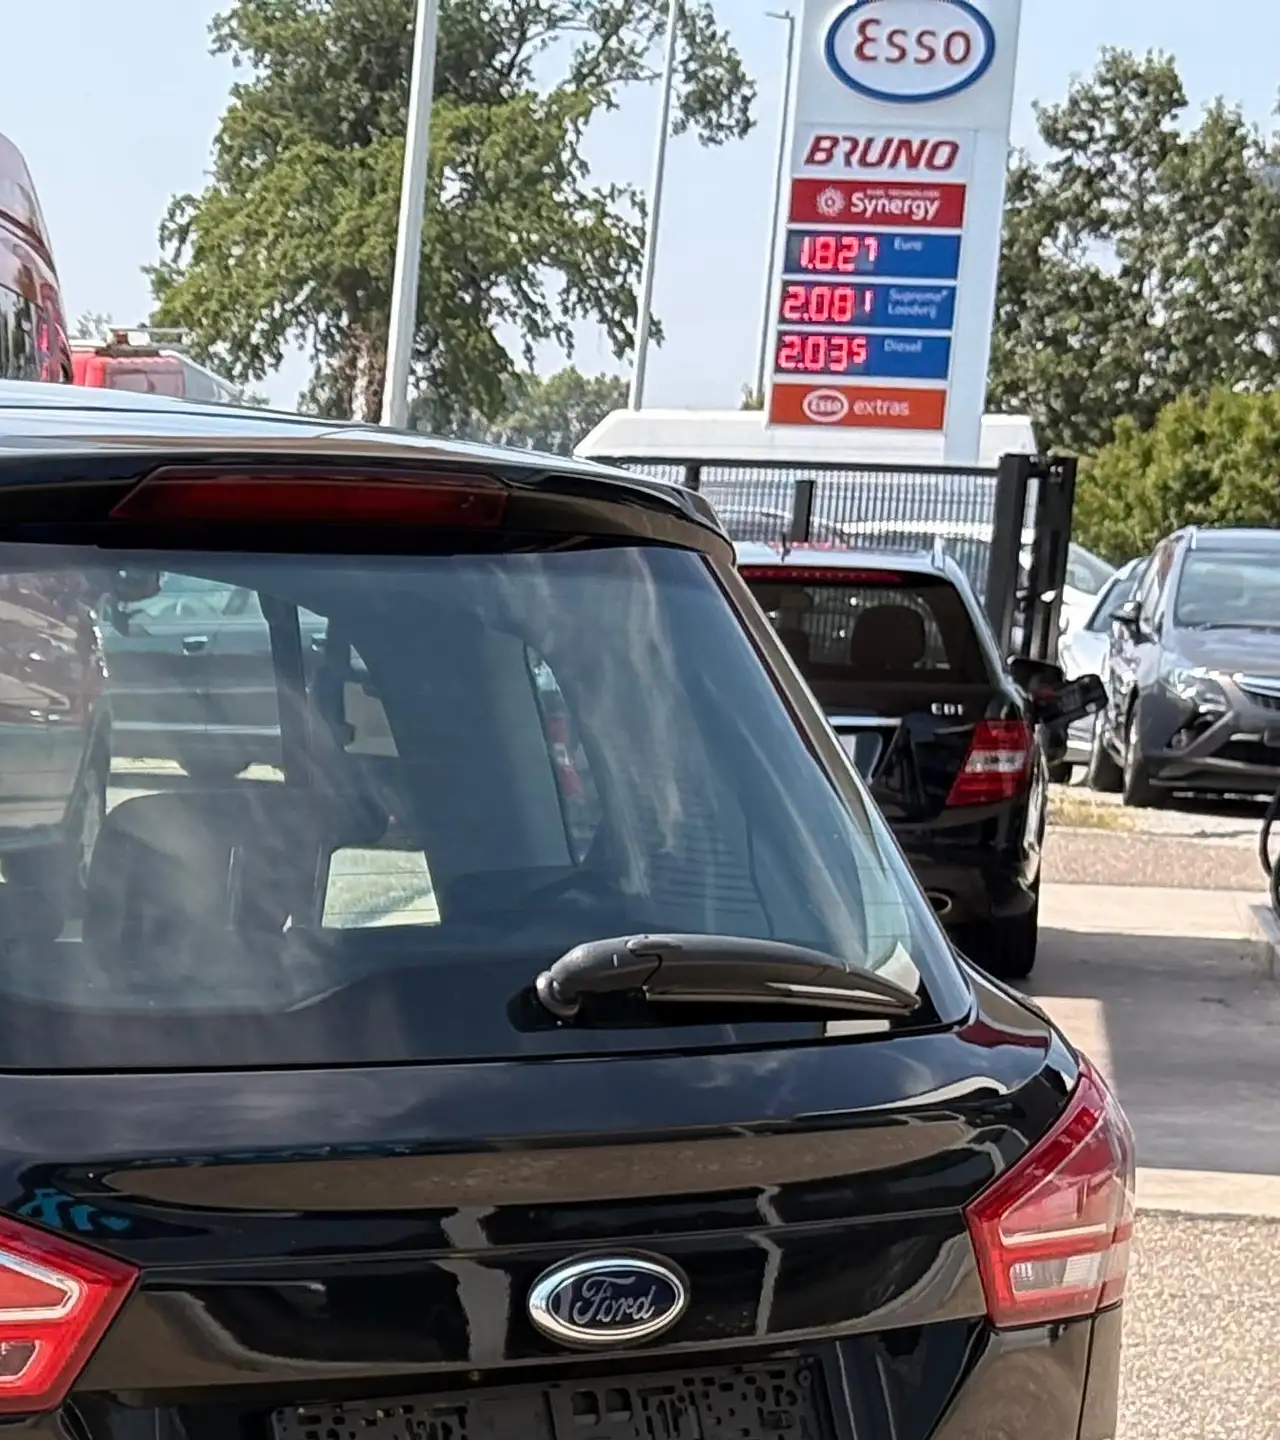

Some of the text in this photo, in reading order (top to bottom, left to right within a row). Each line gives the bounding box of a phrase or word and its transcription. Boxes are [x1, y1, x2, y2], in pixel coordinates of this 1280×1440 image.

[803, 134, 960, 172] BRUNO
[850, 191, 940, 221] Synergy
[883, 339, 923, 354] Diesel
[853, 399, 910, 416] extras
[572, 1275, 657, 1325] Ford
